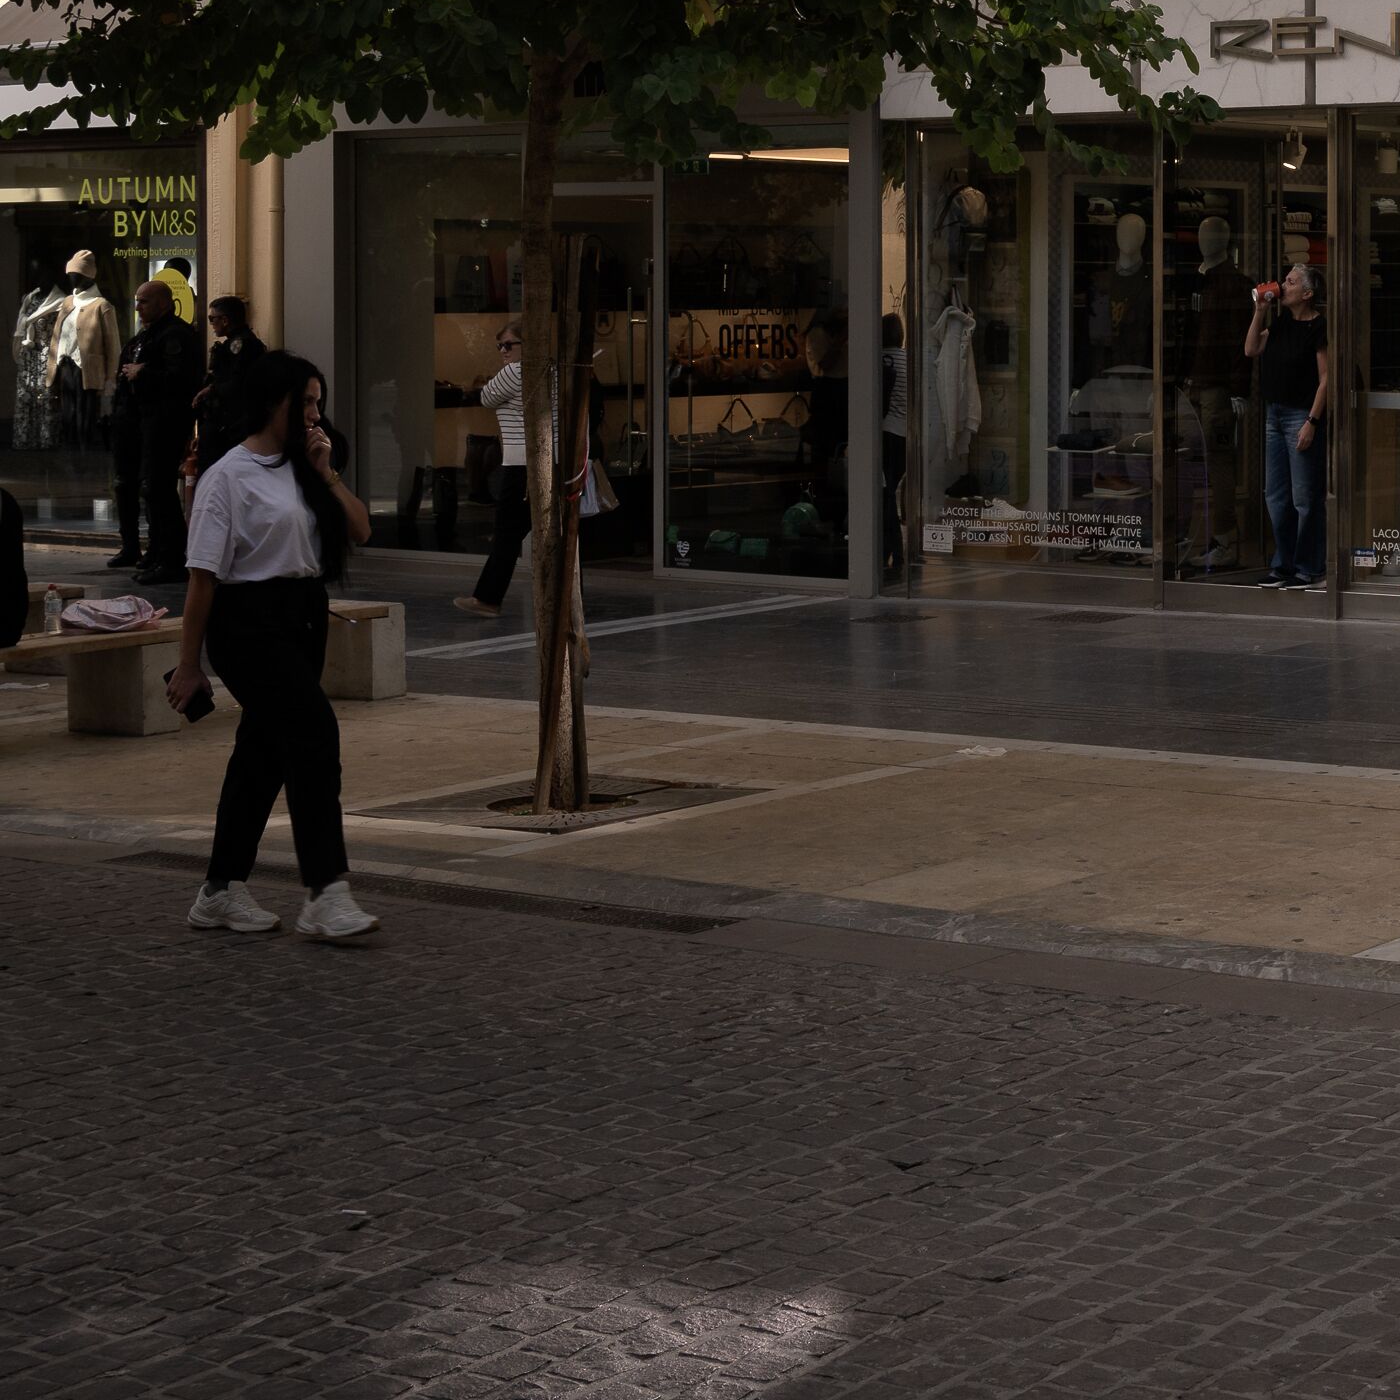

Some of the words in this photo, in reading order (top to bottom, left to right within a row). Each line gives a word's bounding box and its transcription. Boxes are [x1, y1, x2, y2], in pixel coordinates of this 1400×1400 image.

[78, 175, 197, 205] AUTUMN
[113, 247, 148, 258] Anything
[150, 247, 163, 256] but
[164, 247, 197, 257] ordinary
[718, 324, 799, 360] OFFERS
[942, 507, 979, 517] LACOSTE
[1004, 509, 1061, 521] TONIANS
[1068, 512, 1101, 523] TOMMY
[1103, 514, 1143, 525] HILFIGER
[992, 521, 1040, 532] TRUSSARDI
[1042, 523, 1070, 534] JEANS
[1077, 525, 1108, 536] CAMEL
[1109, 527, 1142, 538] ACTIVE
[961, 531, 986, 541] POLO
[988, 533, 1016, 543] ASSN.
[1023, 535, 1044, 545] GUY
[1046, 536, 1090, 548] LAROCHE
[1098, 538, 1142, 550] NAUTICA
